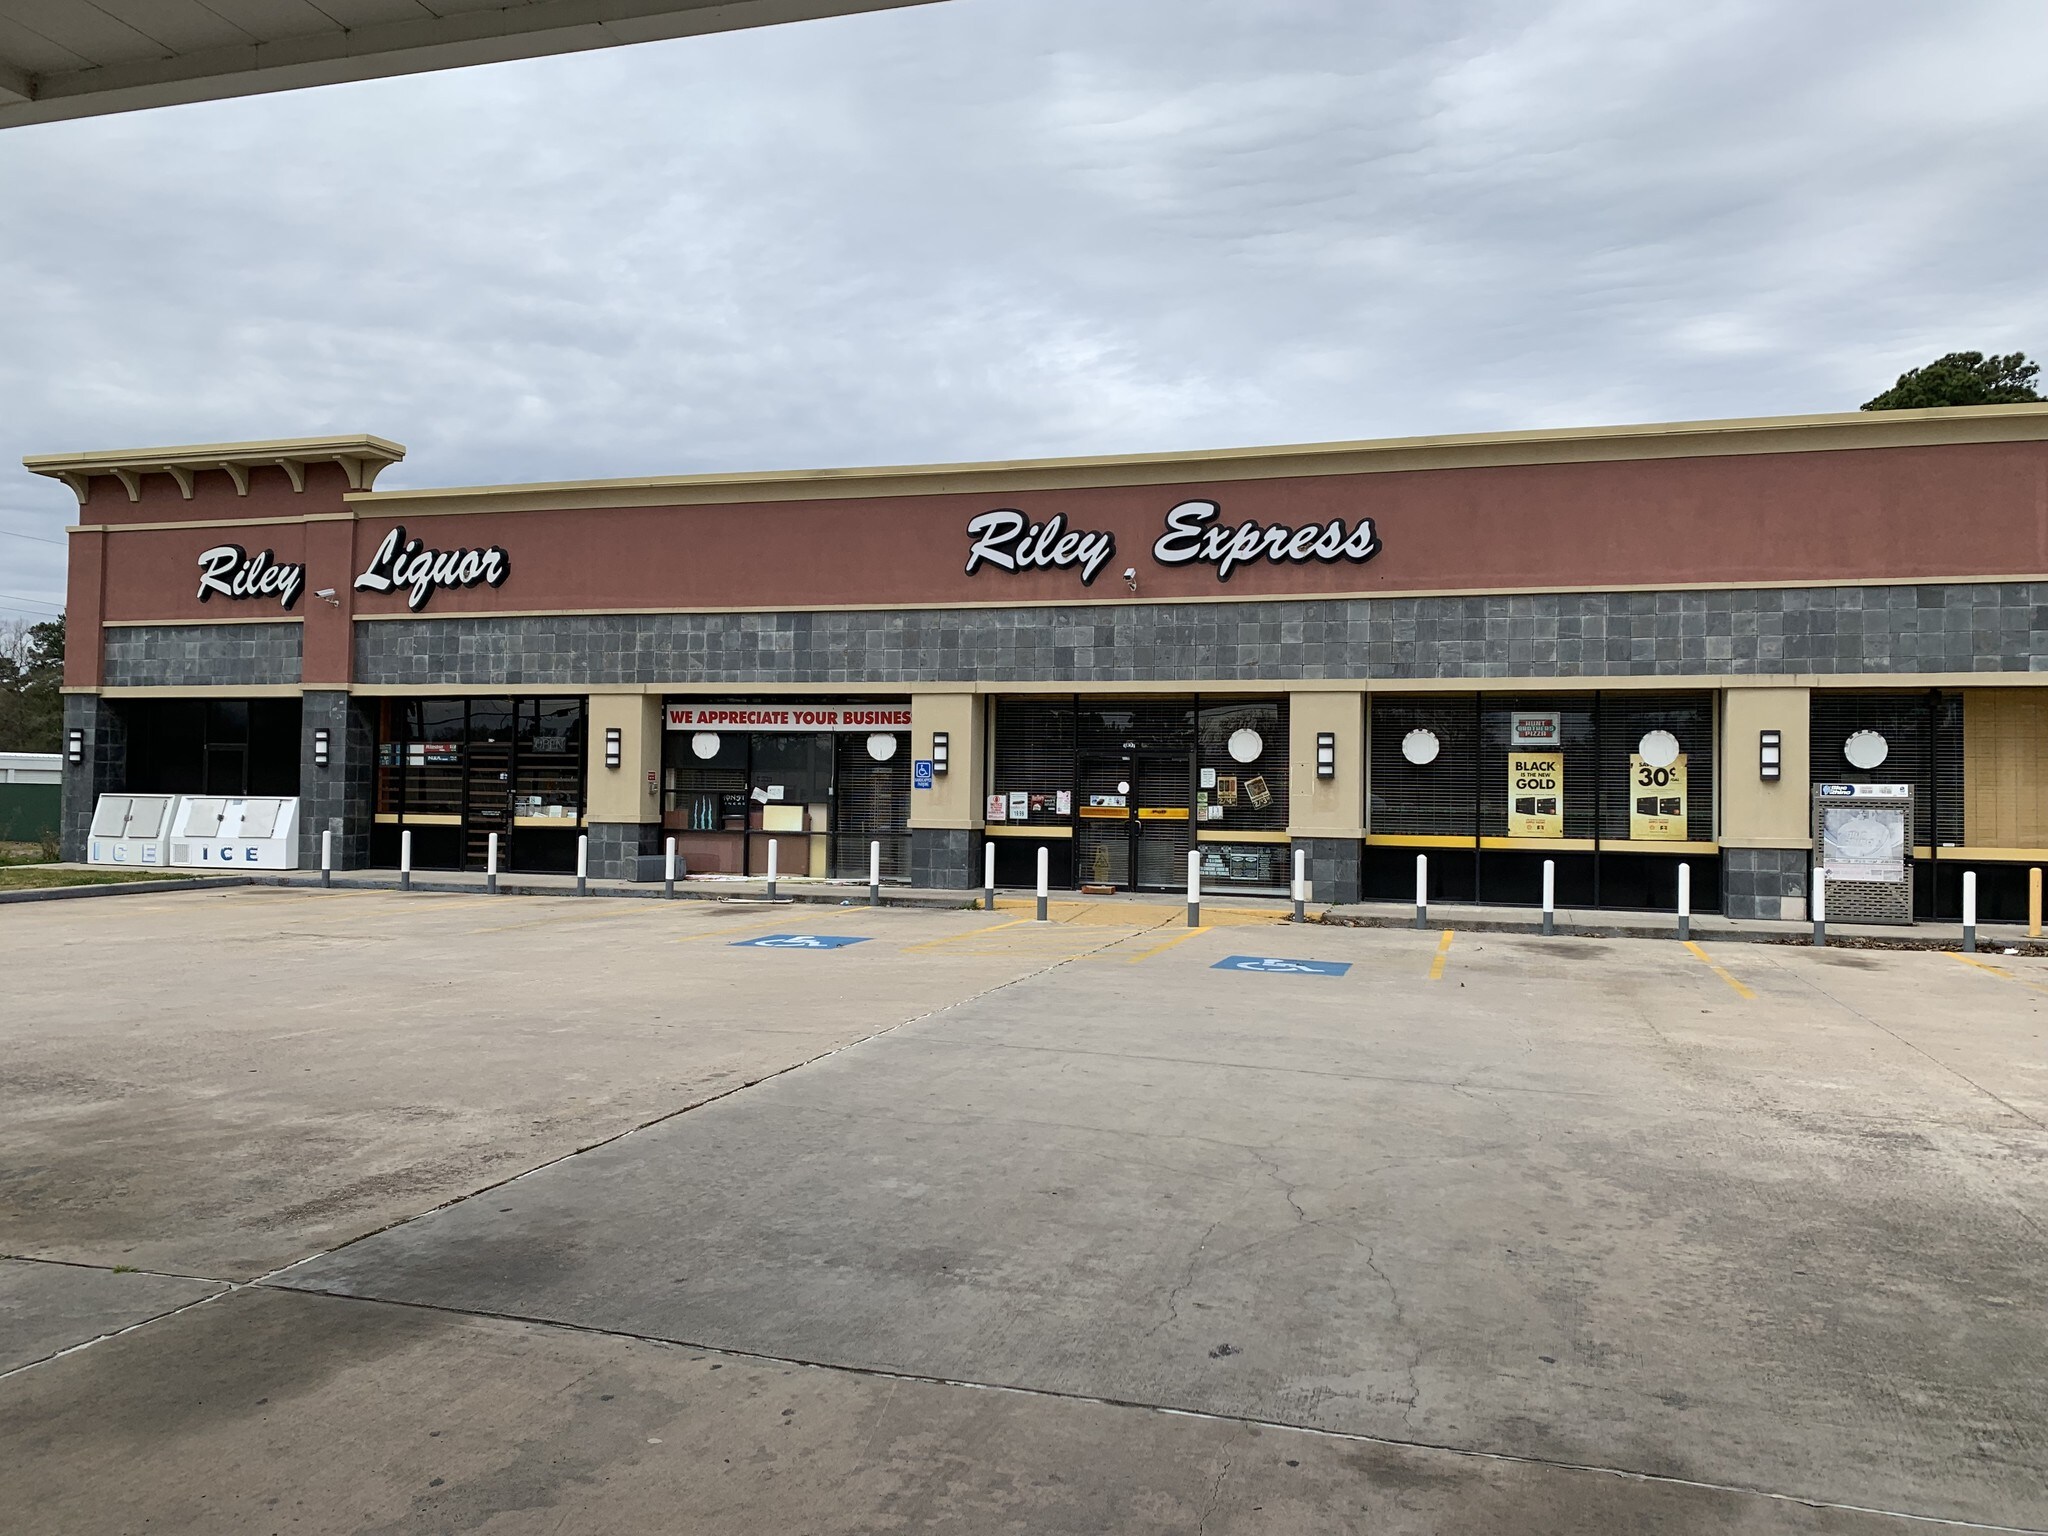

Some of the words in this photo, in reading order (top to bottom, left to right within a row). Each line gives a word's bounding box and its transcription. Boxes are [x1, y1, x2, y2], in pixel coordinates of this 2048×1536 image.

[966, 510, 1114, 583] Riley
[1154, 501, 1379, 579] Express
[197, 545, 305, 608] Riley
[354, 527, 508, 610] Liquor
[670, 710, 693, 725] WE
[696, 710, 789, 726] APPRECIATE
[792, 710, 839, 726] YOUR
[842, 710, 912, 726] BUSINES
[534, 738, 565, 750] OPEN
[1515, 761, 1556, 771] BLACK
[1516, 778, 1556, 790] GOLD
[93, 842, 157, 863] ICE
[202, 844, 259, 862] ICE
